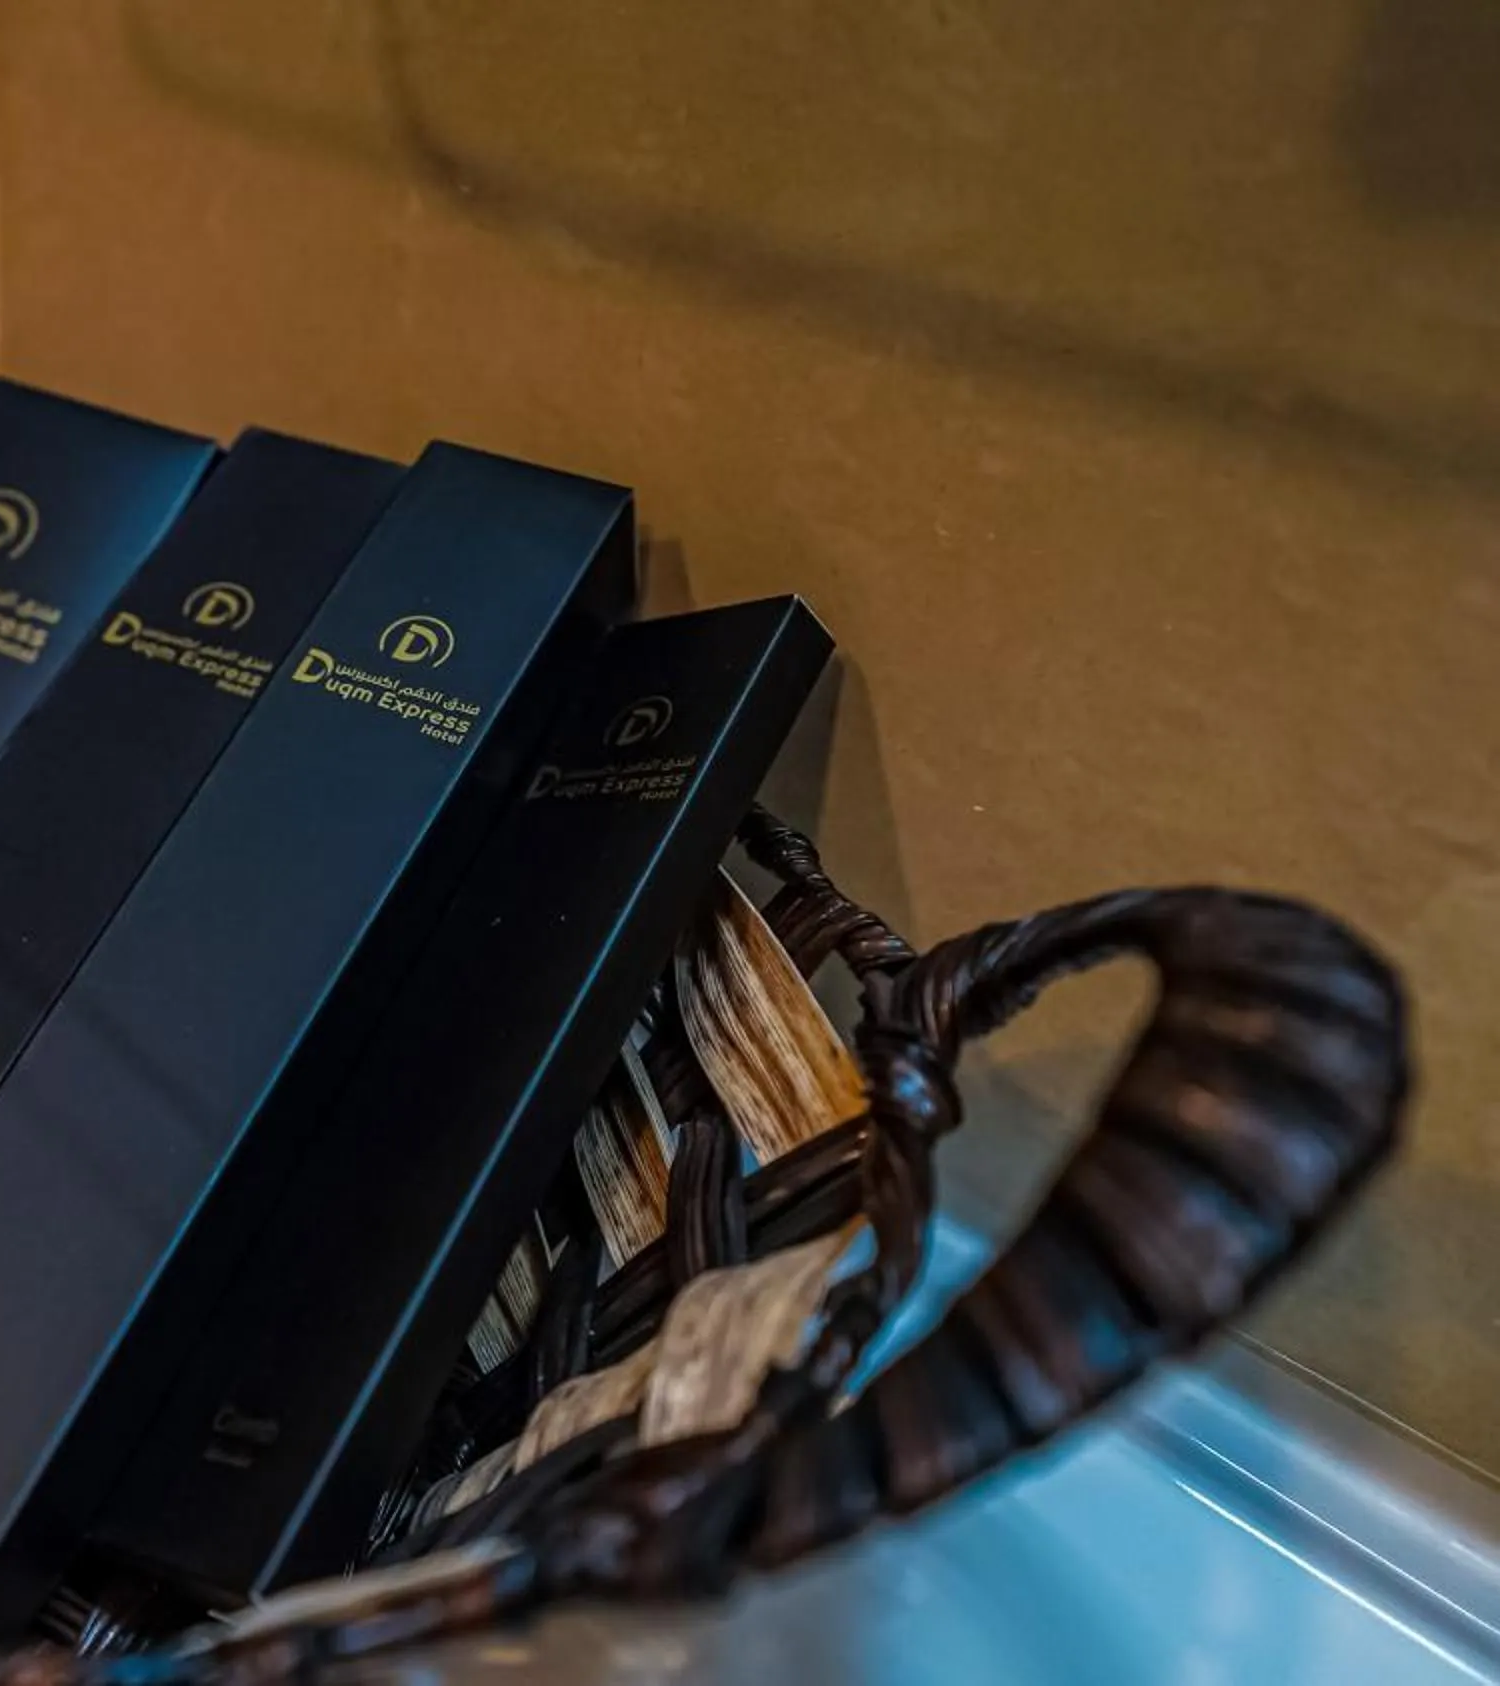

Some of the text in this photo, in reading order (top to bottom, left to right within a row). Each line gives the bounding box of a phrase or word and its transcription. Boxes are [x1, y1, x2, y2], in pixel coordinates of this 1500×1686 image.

[178, 651, 263, 686] Express
[292, 647, 373, 704] Duqm
[377, 691, 472, 733] Express
[420, 723, 464, 745] Hotel
[601, 773, 686, 795] Express
